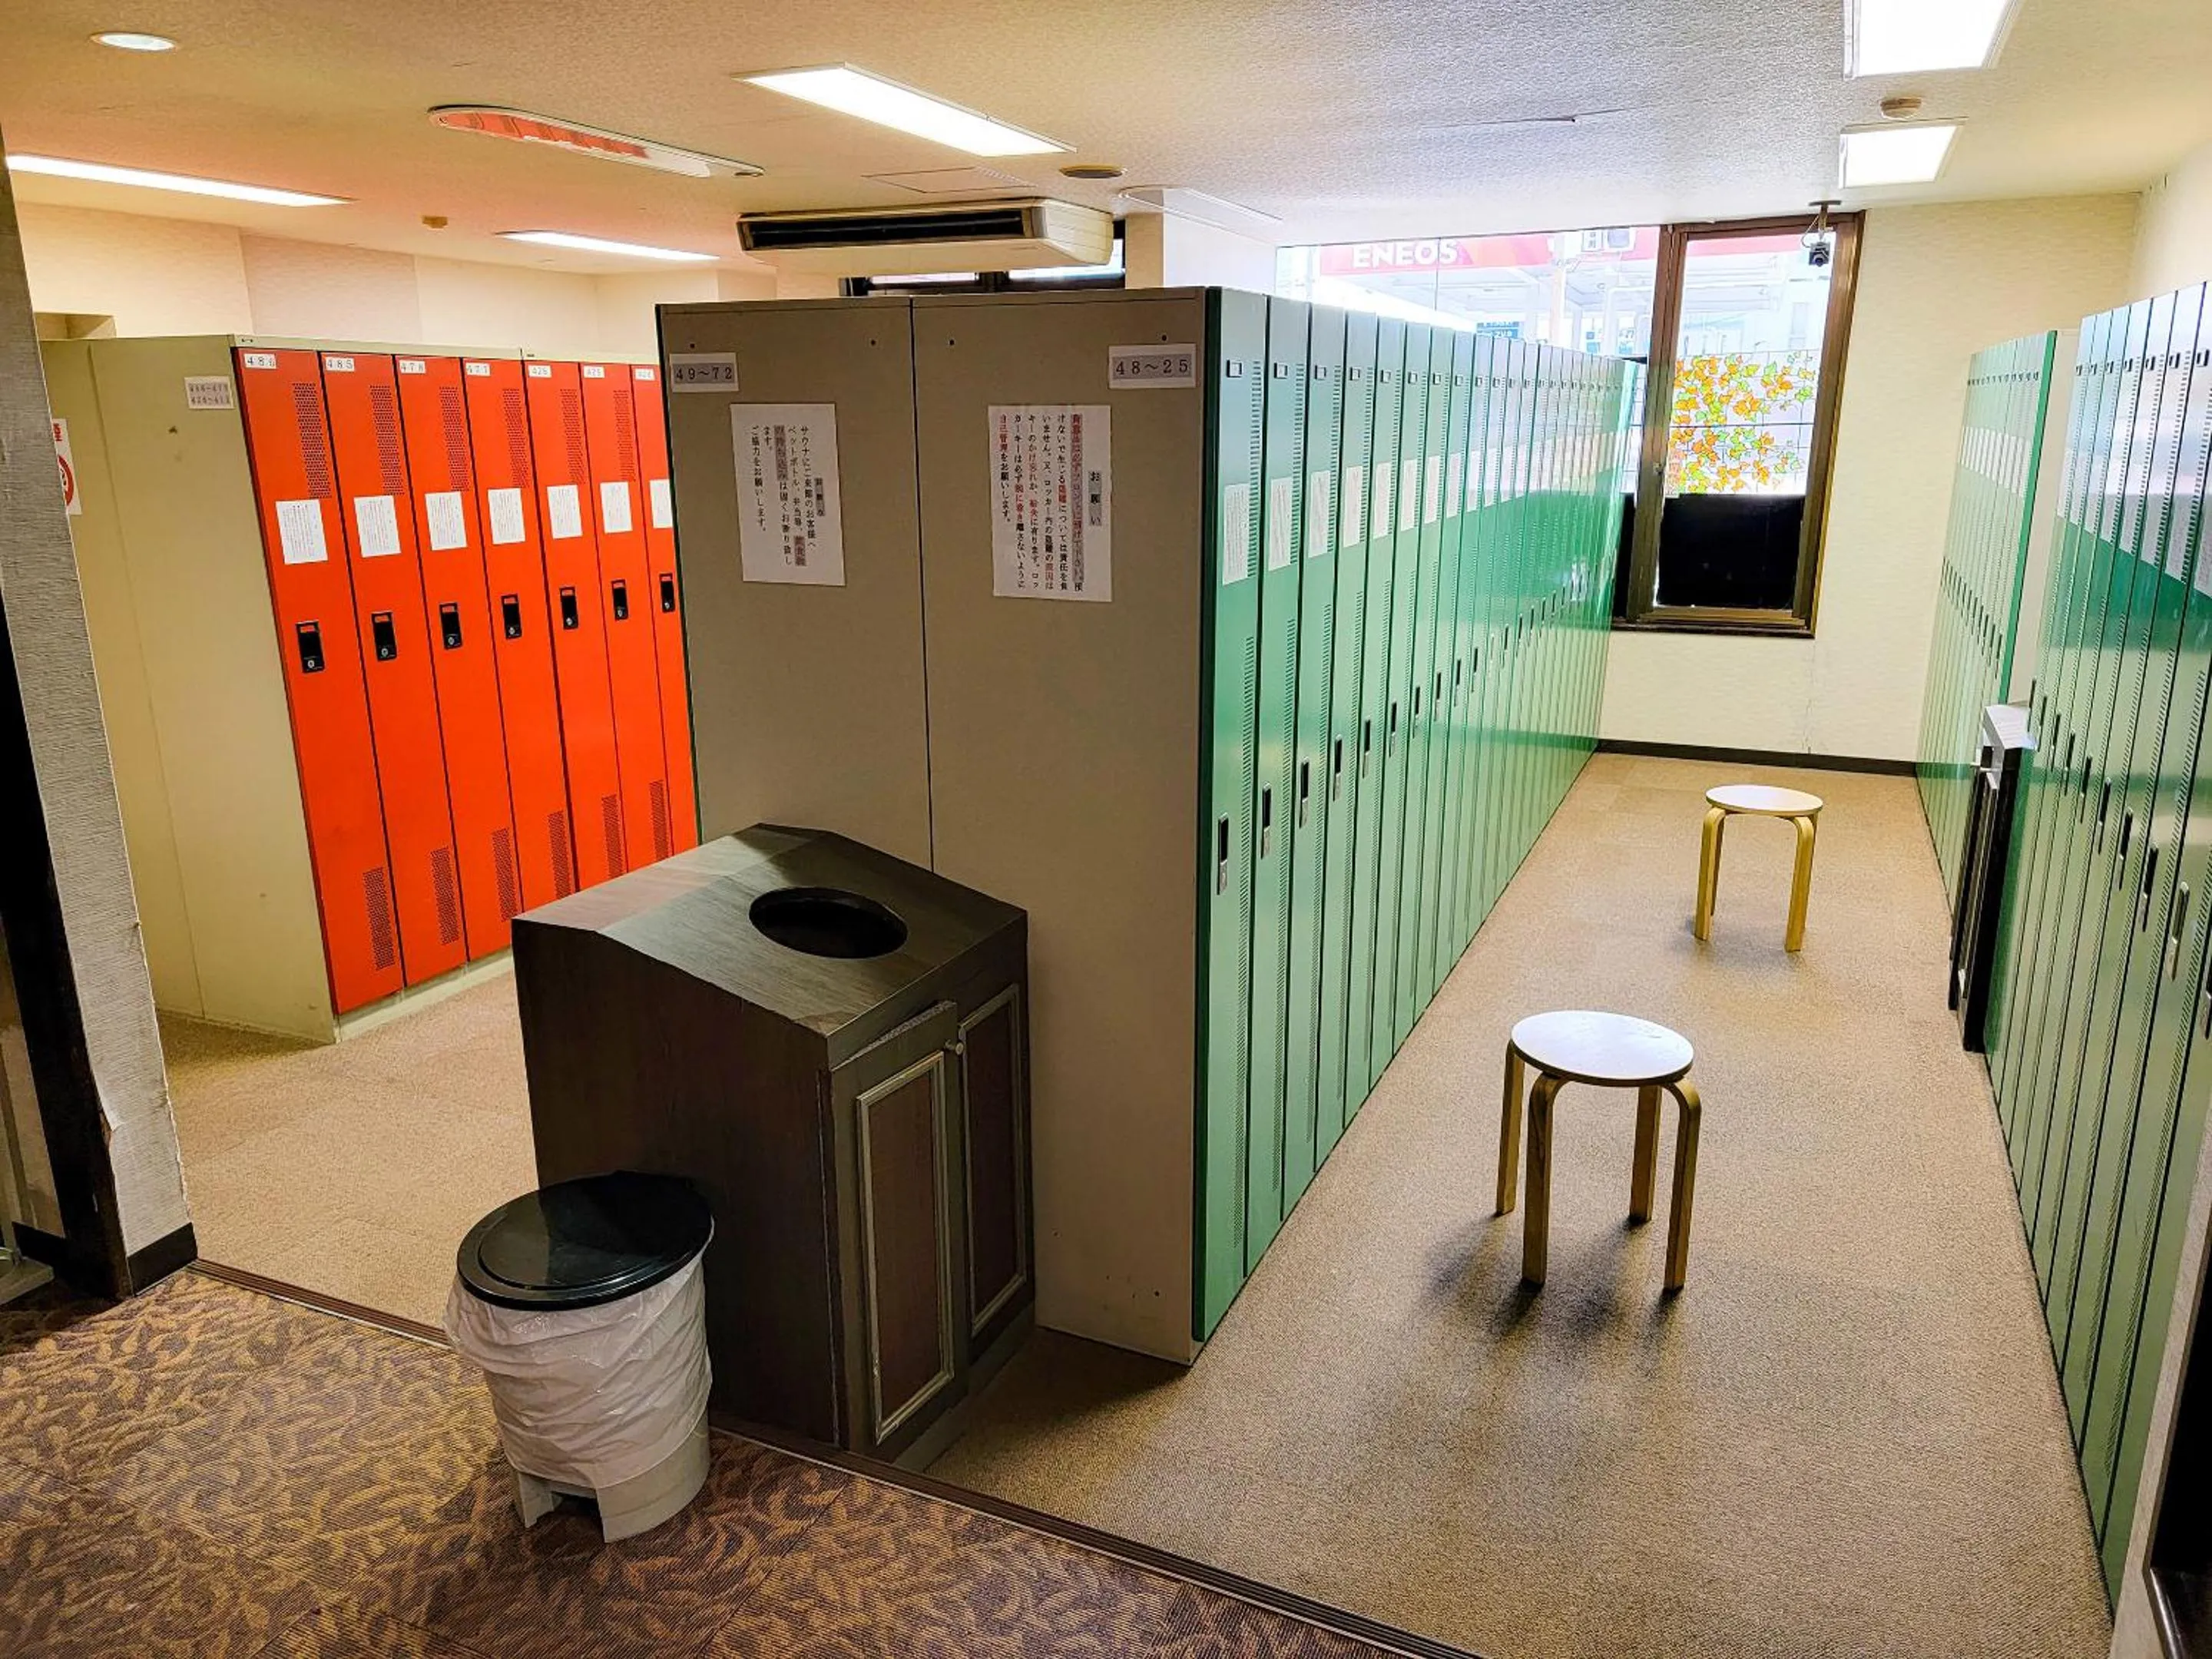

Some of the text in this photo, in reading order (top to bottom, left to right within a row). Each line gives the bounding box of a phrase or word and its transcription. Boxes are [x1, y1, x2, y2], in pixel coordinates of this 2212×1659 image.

[1353, 239, 1459, 268] ENEOS
[327, 359, 353, 369] 485
[1089, 471, 1101, 525] お願い
